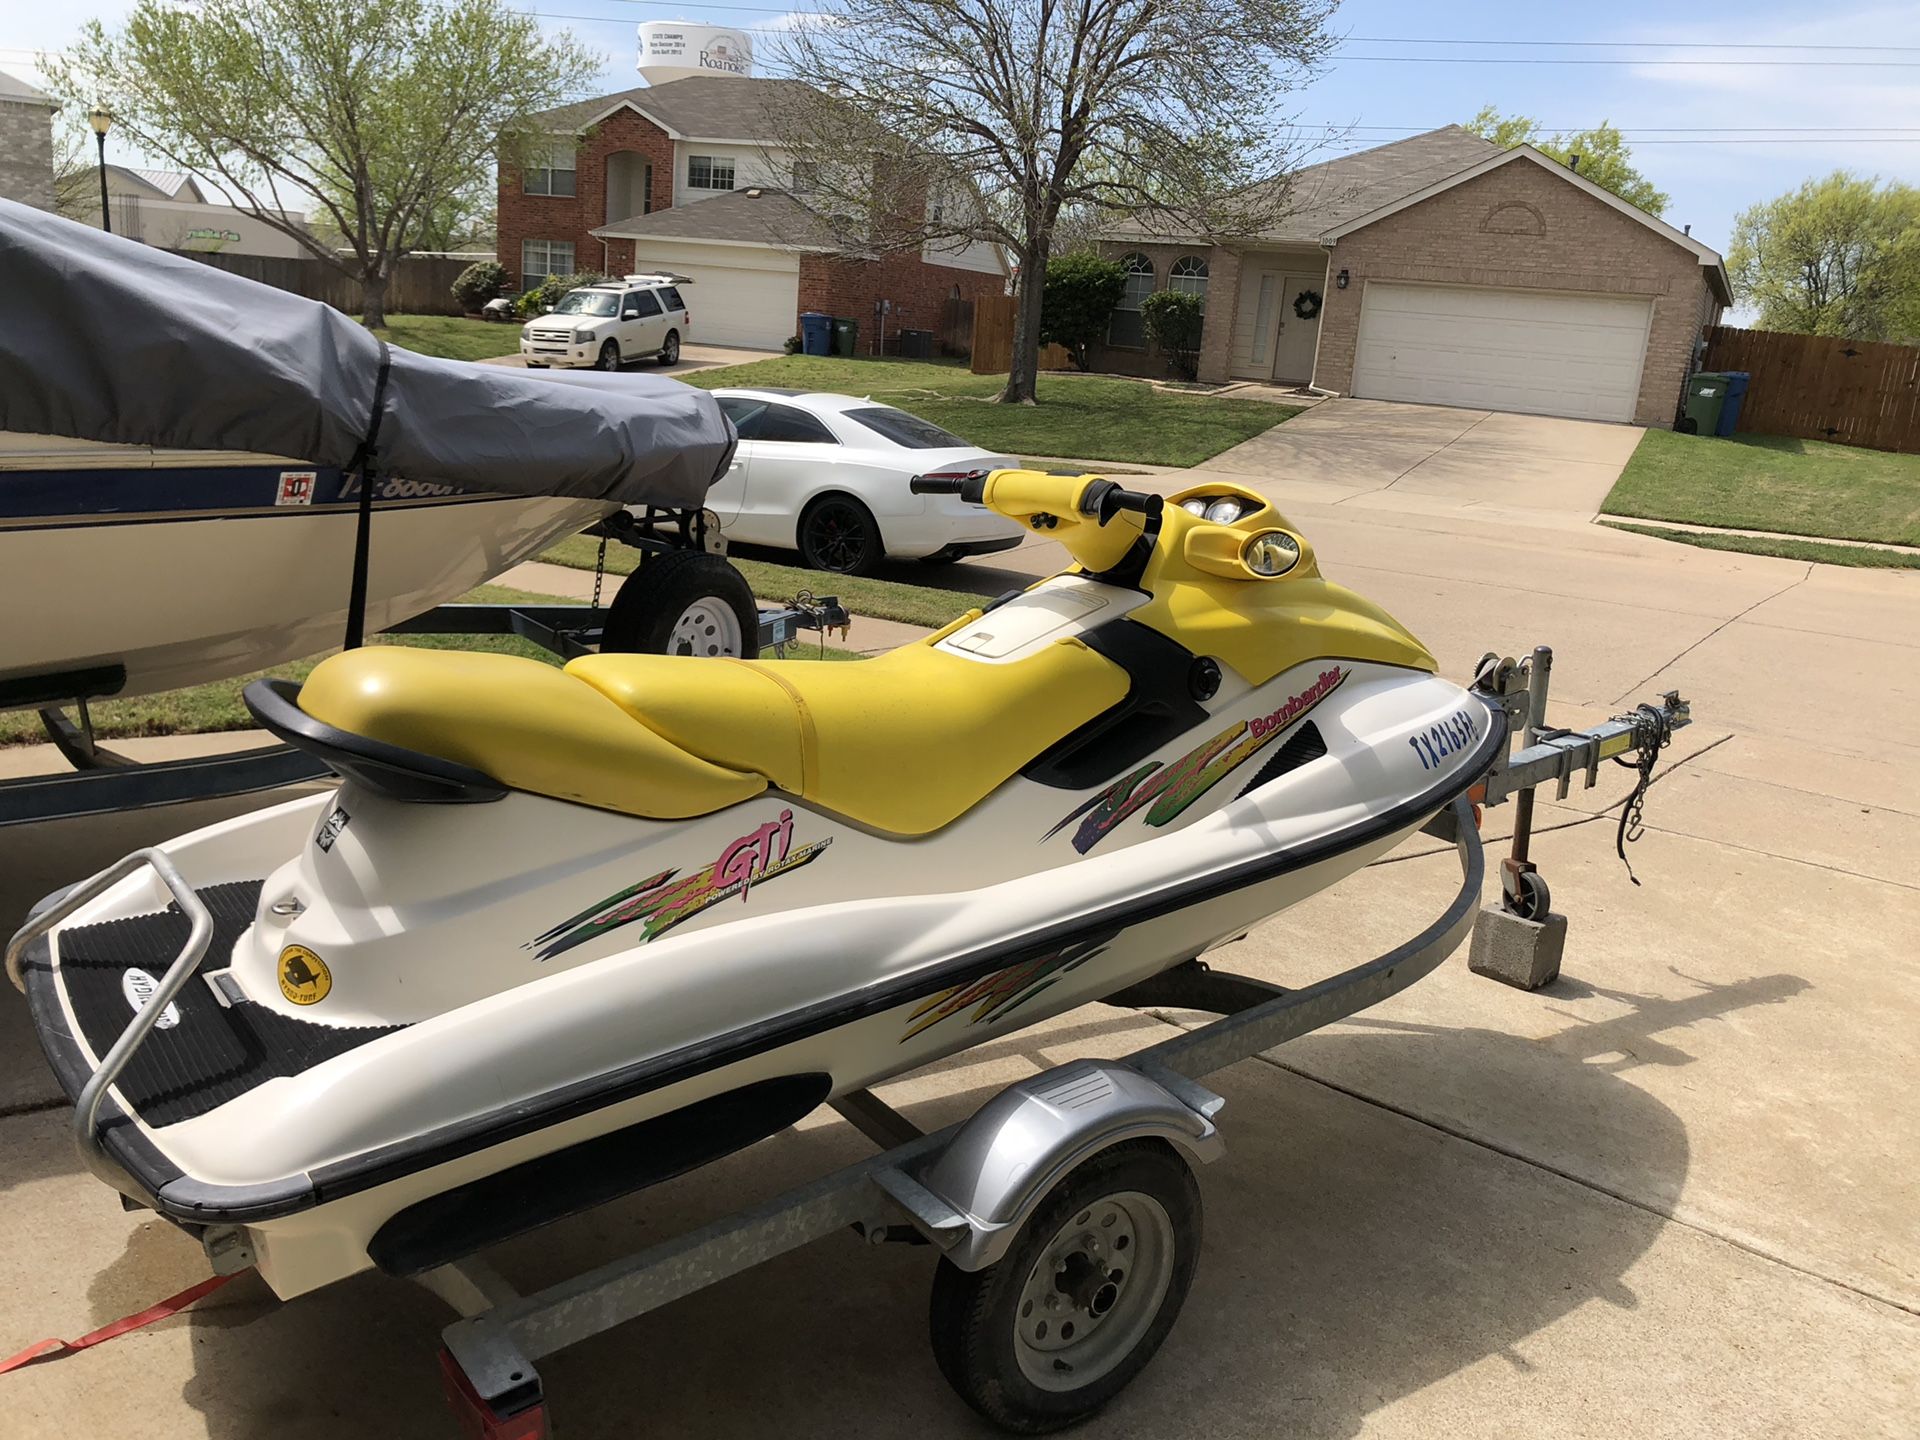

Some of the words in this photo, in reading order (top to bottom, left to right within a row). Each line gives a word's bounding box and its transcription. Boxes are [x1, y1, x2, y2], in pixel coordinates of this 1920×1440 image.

[699, 51, 745, 74] Roanoke
[1249, 665, 1341, 739] Bombardier
[705, 877, 750, 903] POWERED
[752, 870, 765, 881] BY
[767, 854, 801, 874] ROTAX
[798, 836, 833, 860] MARINE
[713, 808, 795, 903] GTi
